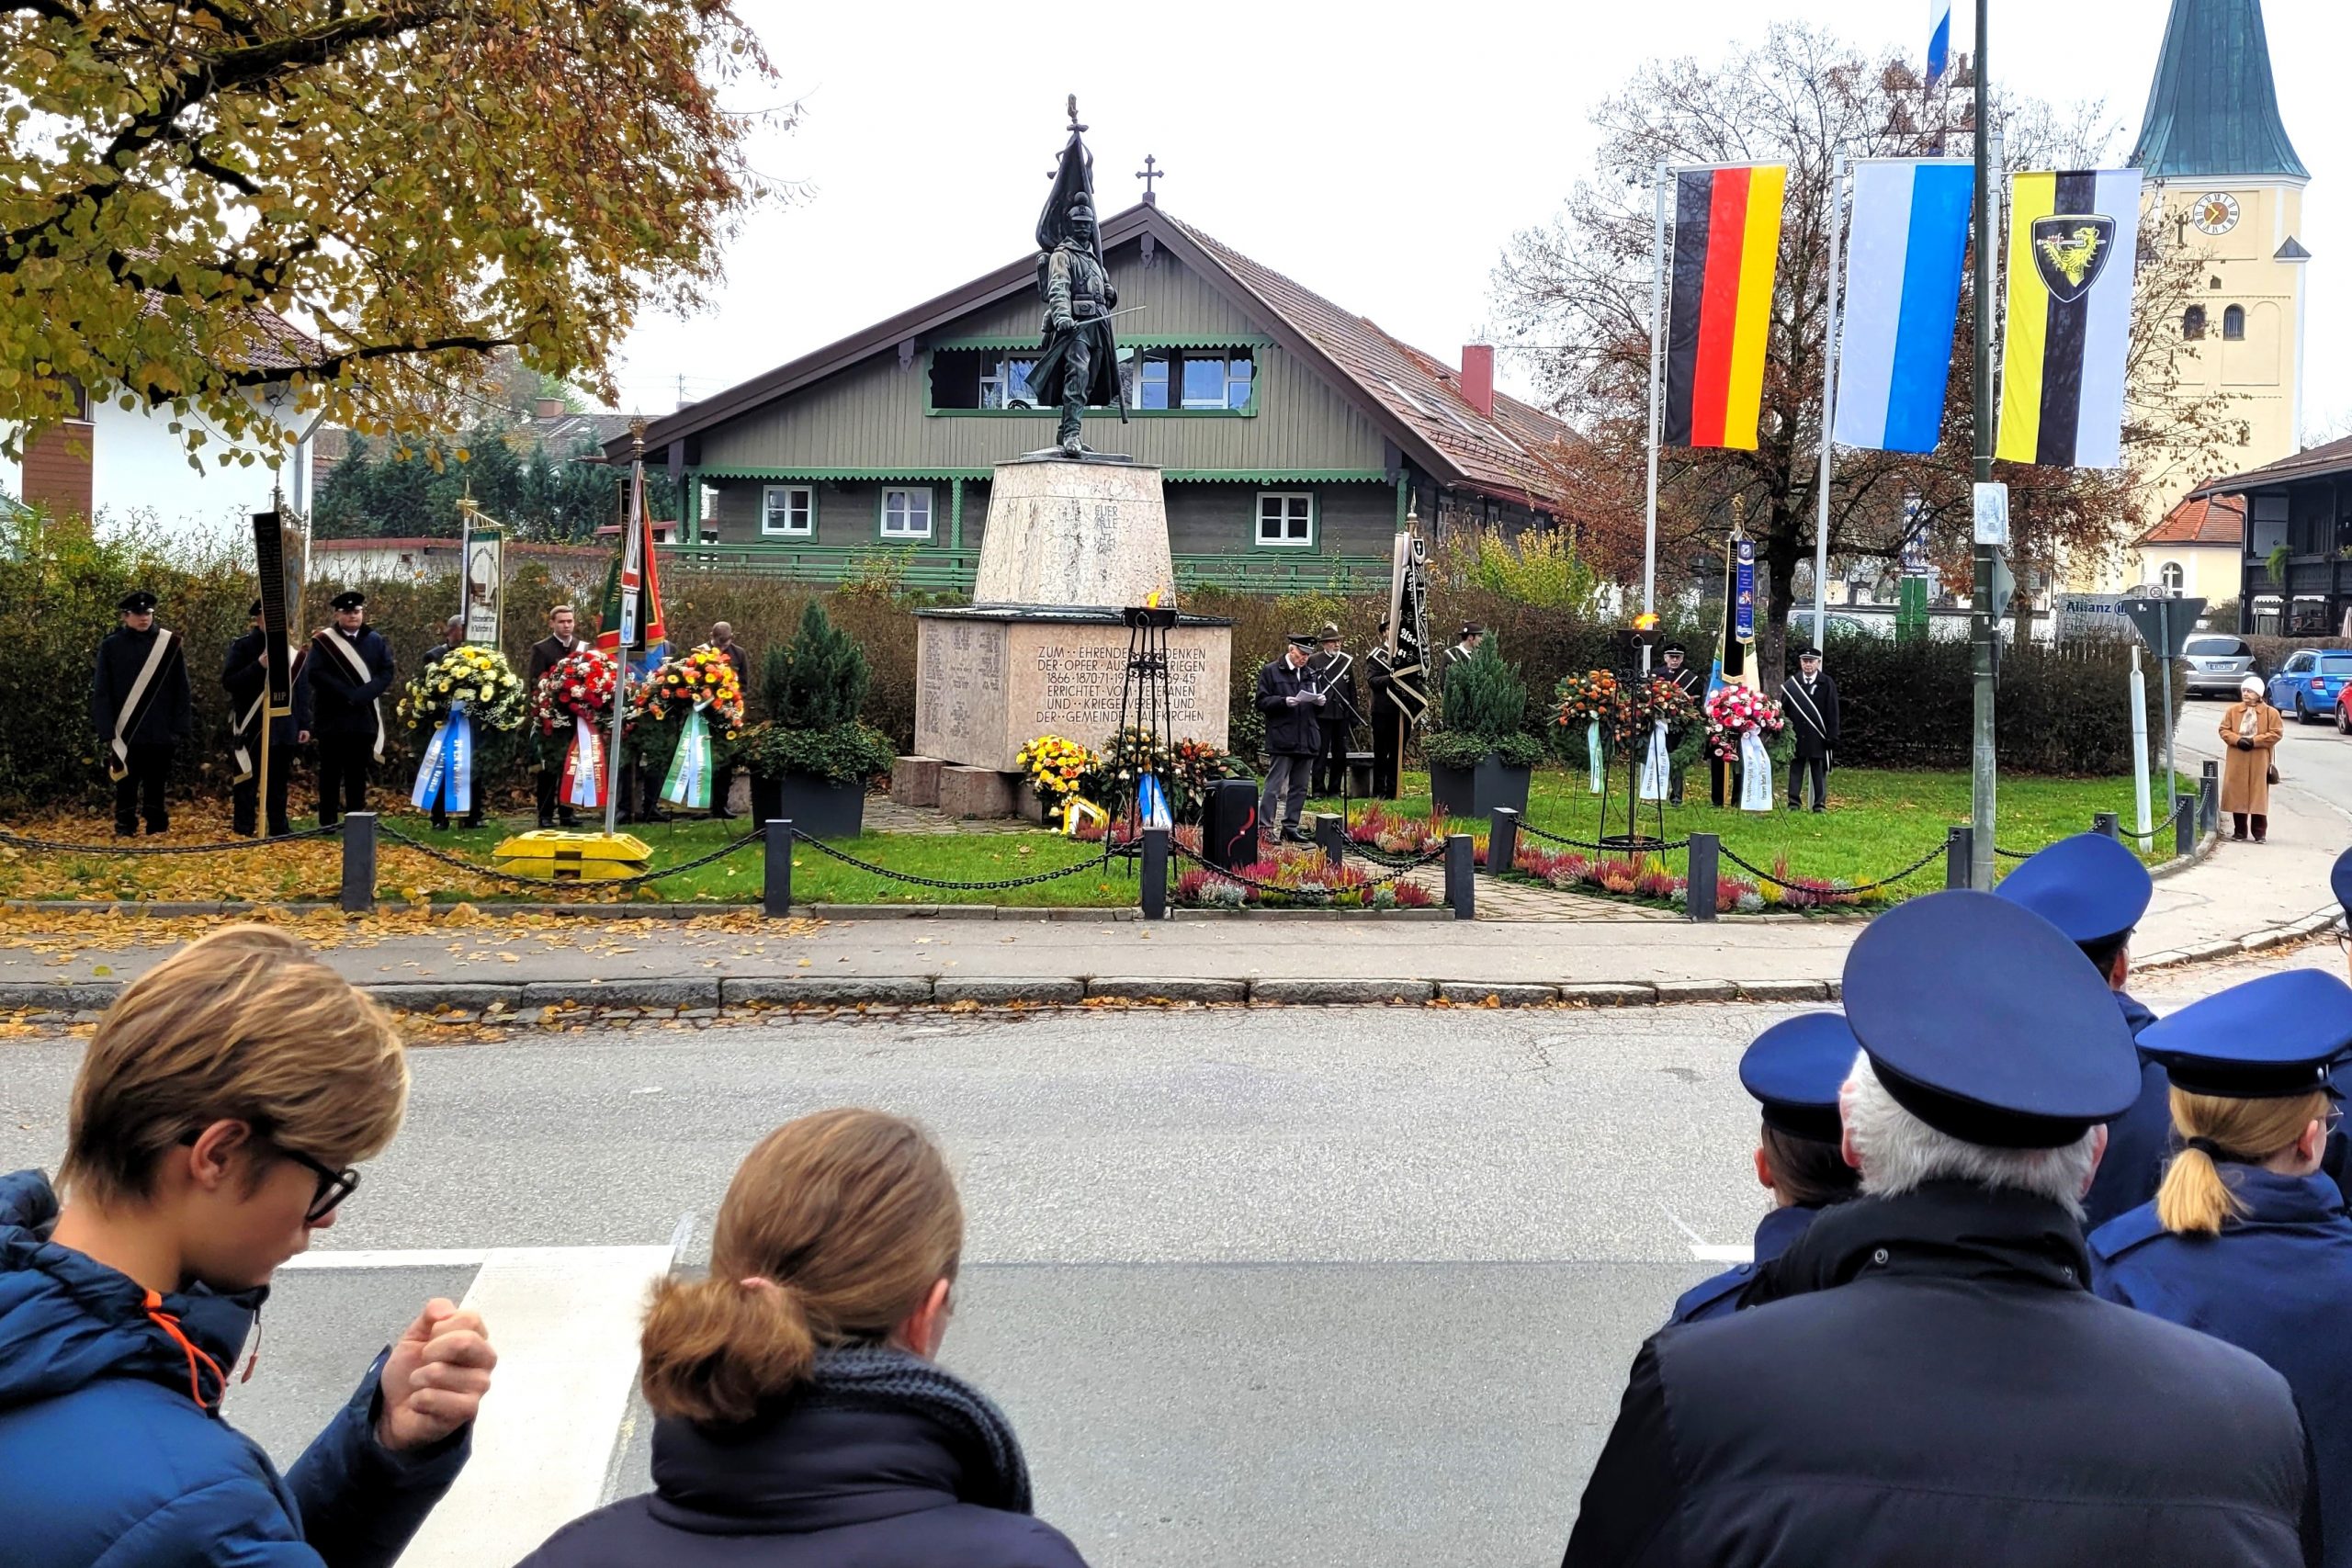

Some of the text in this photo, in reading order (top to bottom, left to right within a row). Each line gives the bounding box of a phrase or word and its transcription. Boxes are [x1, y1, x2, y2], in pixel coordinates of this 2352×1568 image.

[2065, 601, 2111, 613] Allianz
[1038, 646, 1065, 659] ZUM
[1079, 647, 1136, 659] EHRENDE
[1037, 660, 1205, 672] DER OPFER AUS RIEGEN
[1047, 672, 1070, 683] 1866
[1076, 673, 1109, 683] 1870-71
[273, 692, 287, 702] RIP
[1047, 685, 1195, 697] ERRICHTET VOM VEERANEN
[1047, 698, 1195, 709] UND KRIEGEVEREN UND
[1036, 711, 1204, 723] DER GEMEINDE AUFKRCHEN
